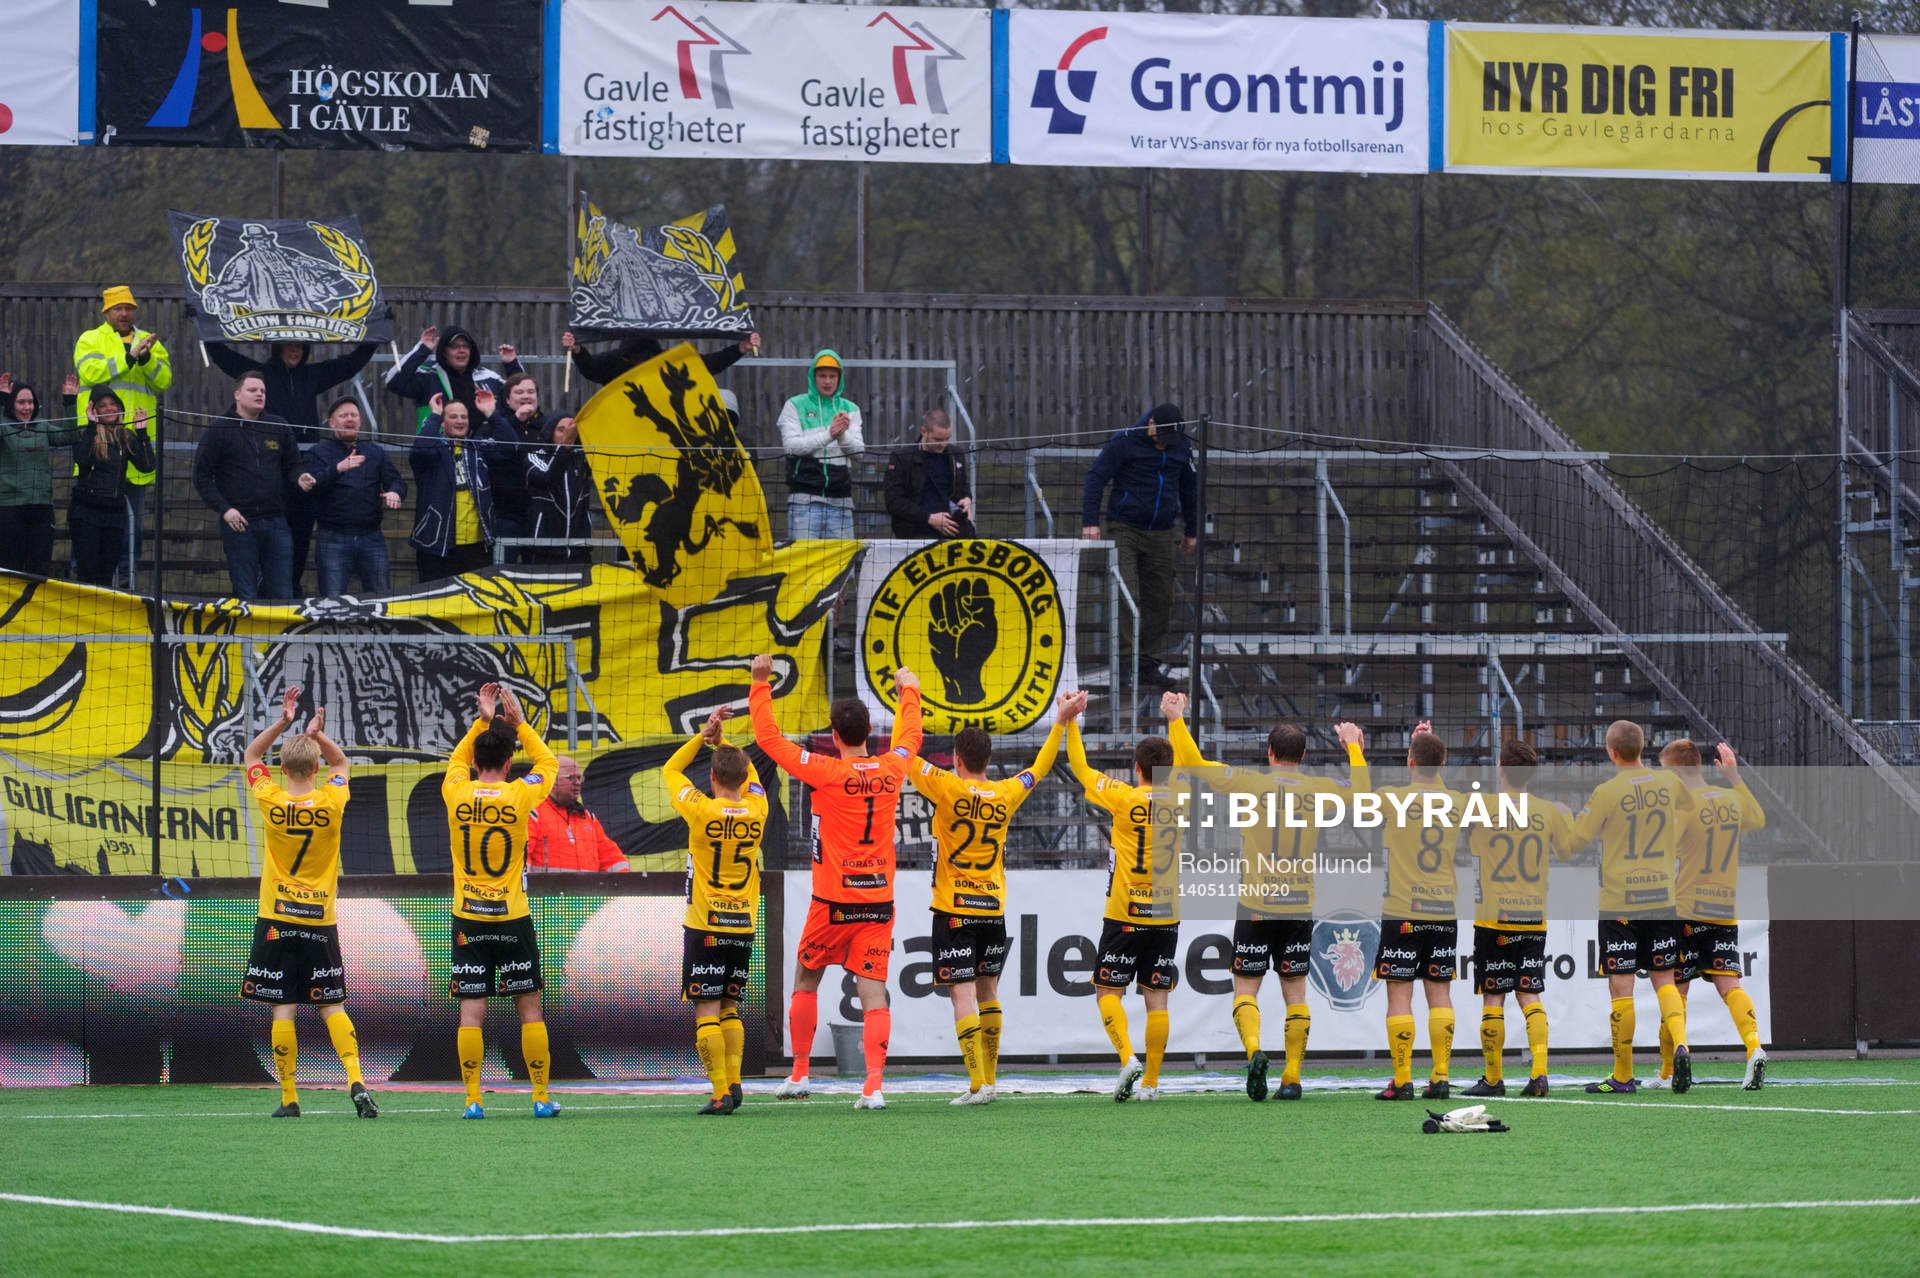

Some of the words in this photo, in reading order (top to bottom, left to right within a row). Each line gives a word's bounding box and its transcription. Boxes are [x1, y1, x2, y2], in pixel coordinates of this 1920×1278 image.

[289, 64, 492, 99] HÖGSKOLAN
[584, 72, 669, 103] Gavle
[801, 78, 885, 108] Gavle
[1131, 57, 1405, 132] Grontmij
[1483, 61, 1568, 113] HYR
[1581, 63, 1656, 117] DIG
[1669, 66, 1734, 118] FRI
[289, 104, 302, 130] I
[309, 99, 411, 132] GÄVLE
[583, 111, 746, 150] fastigheter
[1481, 116, 1525, 136] hos
[1542, 118, 1736, 144] Gavlegårdarna
[801, 115, 960, 155] fastigheter
[1131, 136, 1144, 149] Vi
[1148, 137, 1168, 149] tar
[1170, 137, 1250, 151] VVS-ansvar
[1252, 137, 1271, 151] för
[1275, 140, 1300, 154] nya
[1303, 138, 1404, 153] fotbollsarenan
[225, 314, 280, 334] YELLOW
[286, 314, 360, 338] FANATICS
[264, 330, 321, 339] 2001
[873, 587, 901, 622] IF
[902, 540, 1053, 618] ELFSBORG
[946, 714, 998, 734] THE
[1003, 660, 1053, 724] FAITH
[844, 771, 897, 795] ellos
[1620, 784, 1671, 813] ellos
[3, 775, 239, 841] GULIGANERNA
[270, 803, 330, 828] ellos
[456, 797, 518, 825] ellos
[858, 795, 875, 845] 1
[953, 793, 1007, 823] ellos
[103, 836, 136, 856] 1991
[705, 815, 762, 840] ellos
[948, 818, 1003, 871] 25
[1623, 808, 1666, 861] 12
[286, 828, 314, 876] 7
[459, 824, 513, 878] 10
[707, 840, 755, 890] 15
[1130, 825, 1178, 876] 13
[1416, 825, 1444, 873] 8
[1488, 833, 1543, 883] 20
[1700, 823, 1739, 875] 17
[313, 889, 328, 899] BIL
[1381, 946, 1417, 960] jetshop
